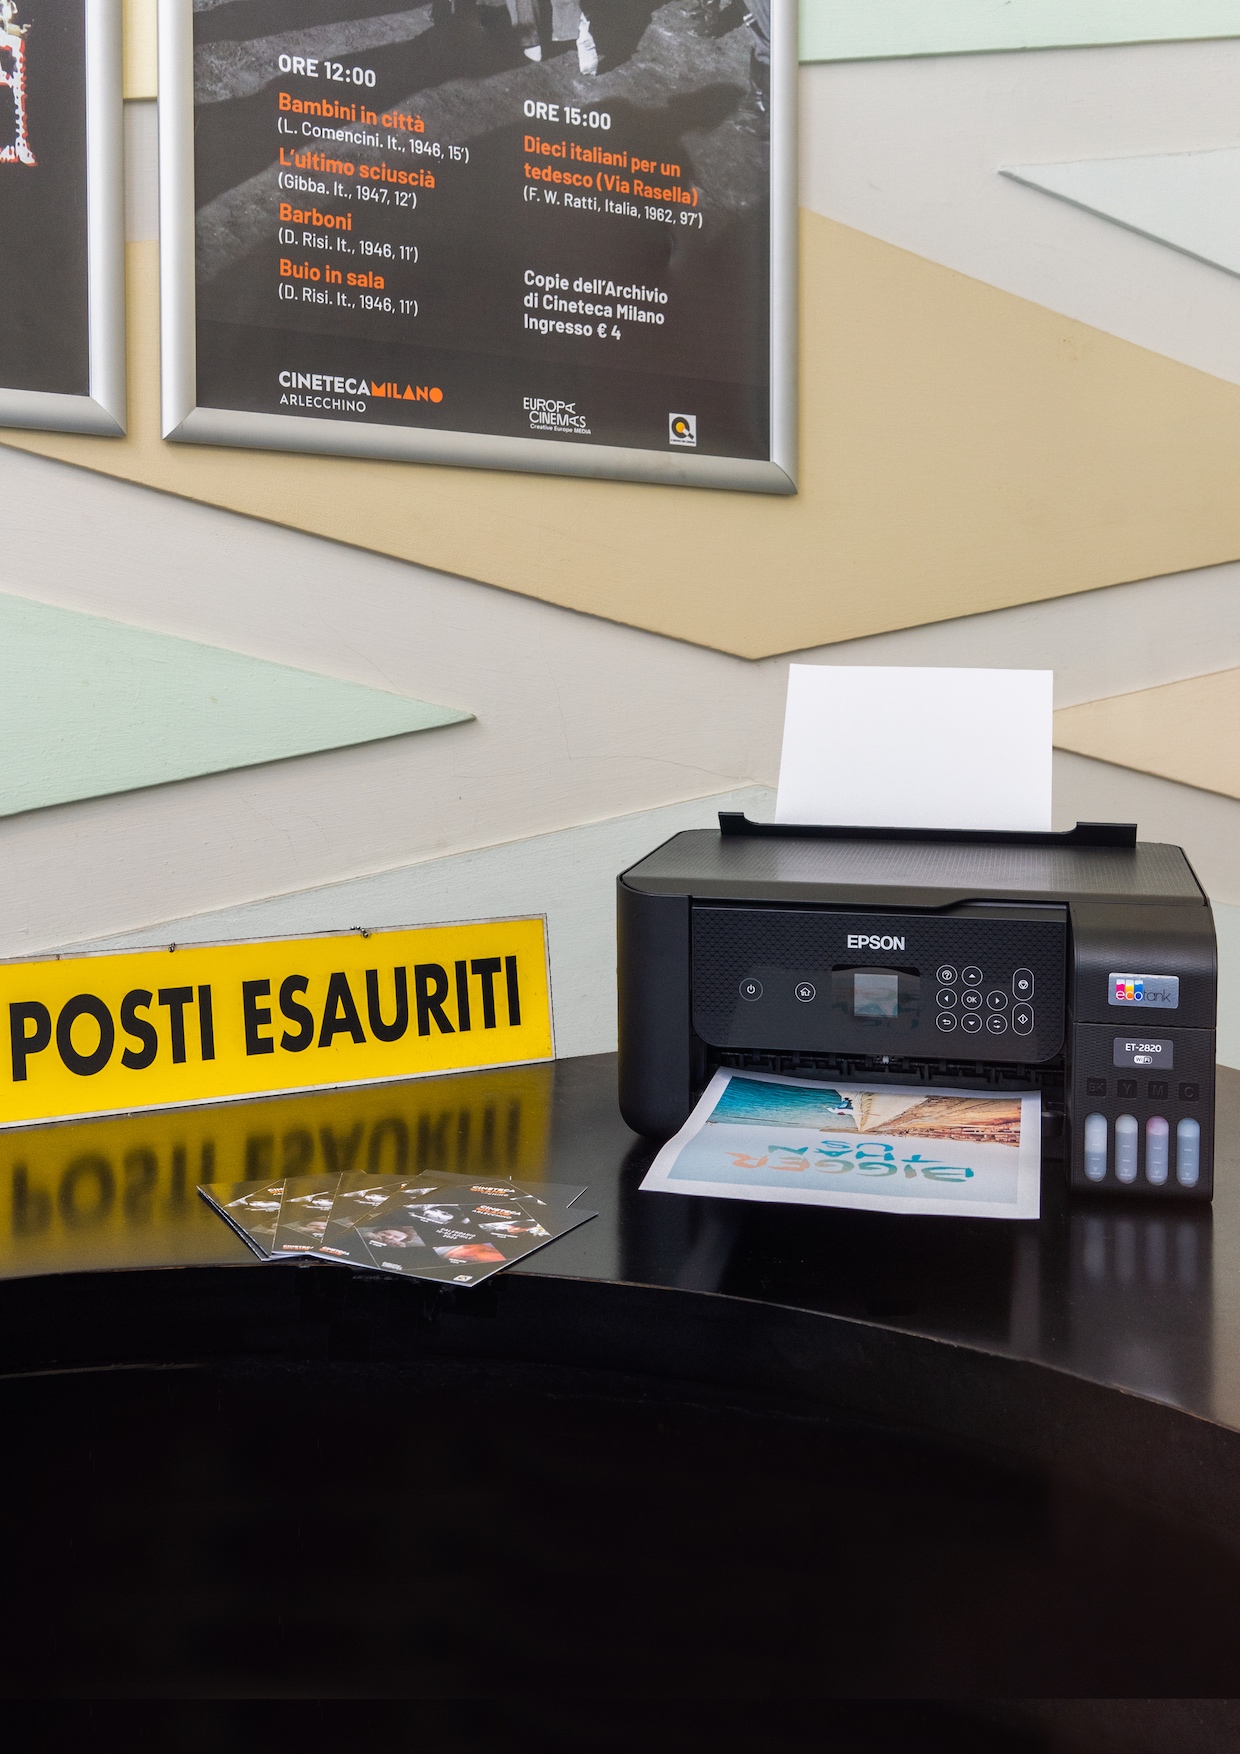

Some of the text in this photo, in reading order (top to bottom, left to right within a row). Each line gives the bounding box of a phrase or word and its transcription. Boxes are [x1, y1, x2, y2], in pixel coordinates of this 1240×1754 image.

[278, 54, 376, 87] ORE 12:00
[278, 92, 424, 133] Bambini in città
[524, 100, 611, 130] ORE 15:00
[278, 116, 298, 134] (L.
[302, 122, 384, 148] Comencini.
[388, 134, 406, 153] It.,
[409, 139, 444, 159] 1946,
[279, 148, 435, 188] L'ultimo sciuscià
[524, 135, 680, 178] Dieci italiani per un
[278, 172, 329, 195] (Gibba.
[334, 181, 352, 200] It.,
[356, 185, 390, 206] 1947,
[524, 162, 698, 207] tedesco (Via Rasella)
[279, 202, 352, 230] Barboni
[524, 185, 540, 202] (F.
[544, 190, 560, 206] W.
[564, 192, 601, 212] Ratti,
[605, 199, 641, 218] Italia,
[644, 206, 676, 224] 1962,
[278, 227, 298, 245] (D.
[302, 232, 332, 250] Risi.
[337, 236, 355, 254] It.,
[359, 240, 396, 260] 1946,
[279, 258, 384, 289] Buio in sala
[524, 270, 668, 304] Copie dell'Archivio
[278, 282, 298, 300] (D.
[302, 287, 332, 304] Risi.
[337, 292, 355, 308] It.,
[359, 294, 396, 314] 1946,
[524, 292, 665, 324] di Cineteca Milano
[524, 313, 621, 340] Ingresso € 4
[279, 394, 366, 412] ARLECCHINO
[523, 397, 576, 414] EUROPA
[529, 410, 586, 428] CINEMAS
[847, 934, 906, 950] EPSON
[966, 996, 978, 1004] OK
[1116, 990, 1171, 1002] ecotank
[10, 955, 522, 1083] POSTI ESAURITI
[1126, 1043, 1162, 1052] ET-2820
[1088, 1083, 1194, 1098] BK Y M C
[724, 1151, 974, 1183] BIGGER
